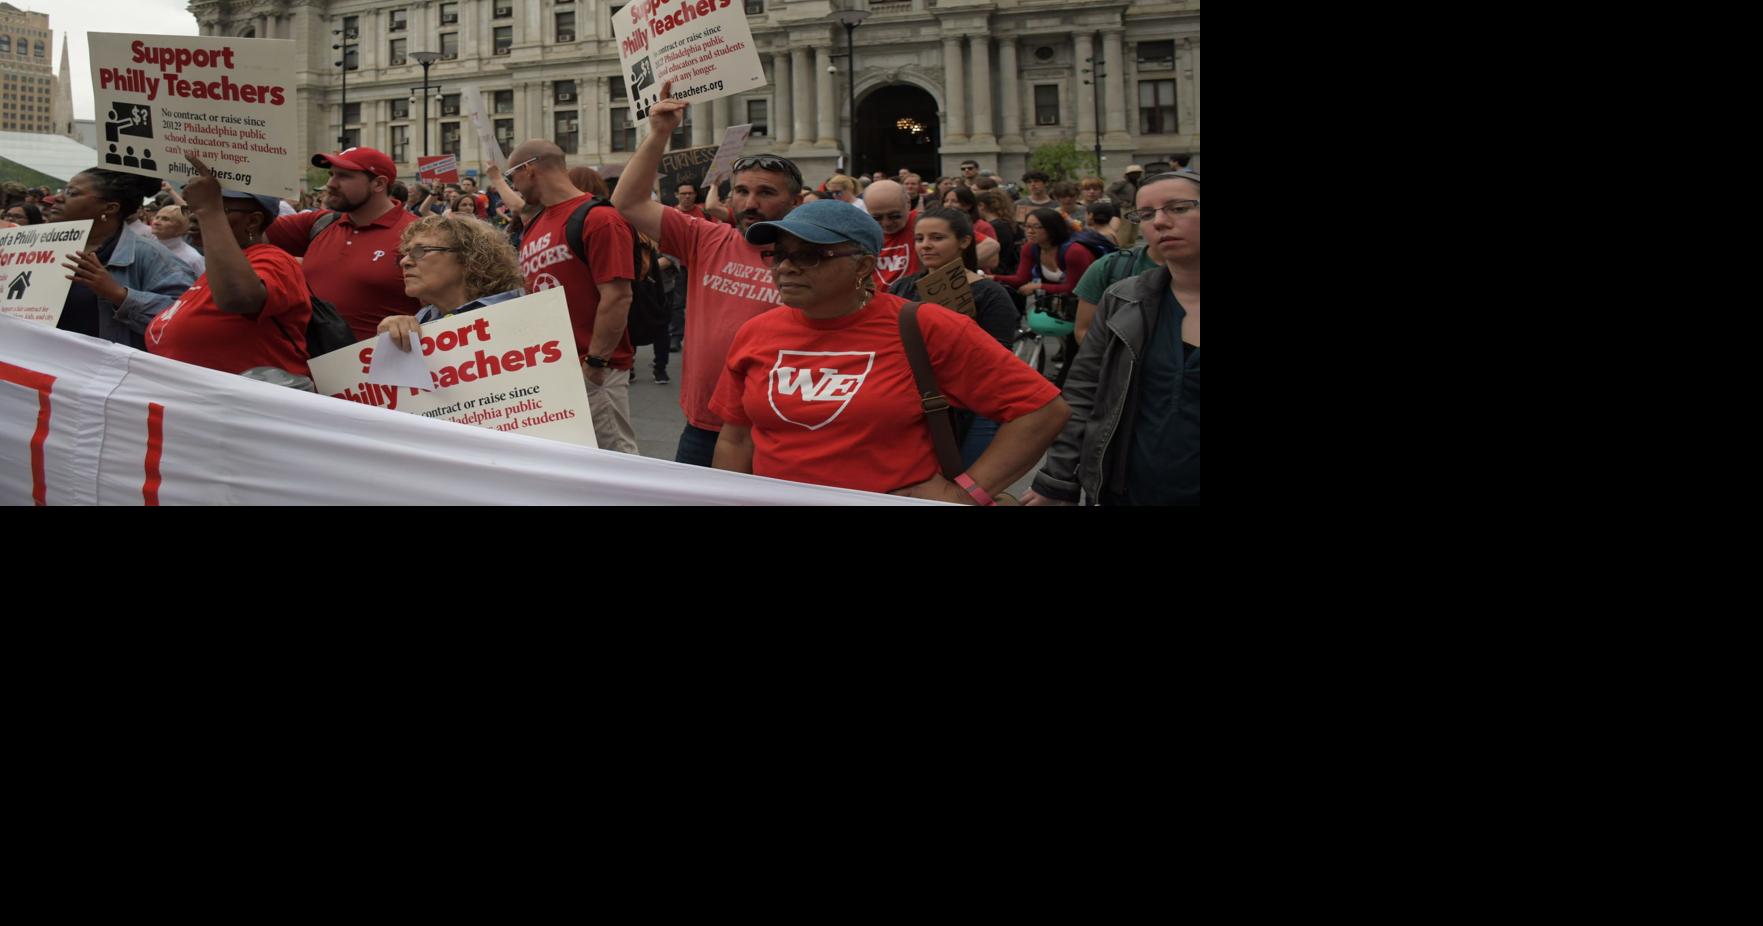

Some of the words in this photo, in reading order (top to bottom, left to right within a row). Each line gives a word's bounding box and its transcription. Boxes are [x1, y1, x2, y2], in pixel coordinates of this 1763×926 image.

[622, 27, 648, 59] Philly
[648, 0, 731, 38] Teachers
[678, 38, 685, 46] or
[686, 32, 703, 43] raise
[703, 24, 722, 37] since
[131, 40, 235, 73] Support
[664, 44, 701, 63] Philadelphia
[702, 35, 725, 51] public
[668, 57, 698, 74] educators
[699, 50, 713, 62] and
[713, 41, 745, 58] students
[680, 71, 692, 81] any
[692, 63, 717, 78] longer.
[99, 68, 160, 101] Philly
[163, 73, 285, 106] Teachers
[161, 108, 172, 117] No
[173, 110, 207, 122] contract
[209, 114, 218, 122] or
[221, 114, 242, 125] raise
[244, 116, 265, 127] since
[162, 120, 182, 131] 2012?
[183, 122, 237, 138] Philadelphia
[239, 126, 266, 140] public
[164, 132, 186, 143] school
[188, 136, 231, 148] educators
[232, 140, 248, 151] and
[249, 143, 287, 156] students
[165, 144, 182, 154] can't
[202, 150, 219, 162] any
[220, 150, 250, 164] longer.
[168, 162, 252, 186] phillytehers.org
[13, 229, 39, 247] Philly
[40, 228, 85, 243] educator
[519, 232, 552, 262] AMS
[15, 250, 55, 265] now.
[521, 244, 573, 278] OCCER
[776, 366, 864, 402] WE
[463, 398, 476, 410] or
[478, 391, 506, 408] raise
[509, 383, 540, 400] since
[496, 418, 519, 432] and
[521, 407, 575, 430] students
[505, 398, 543, 420] public
